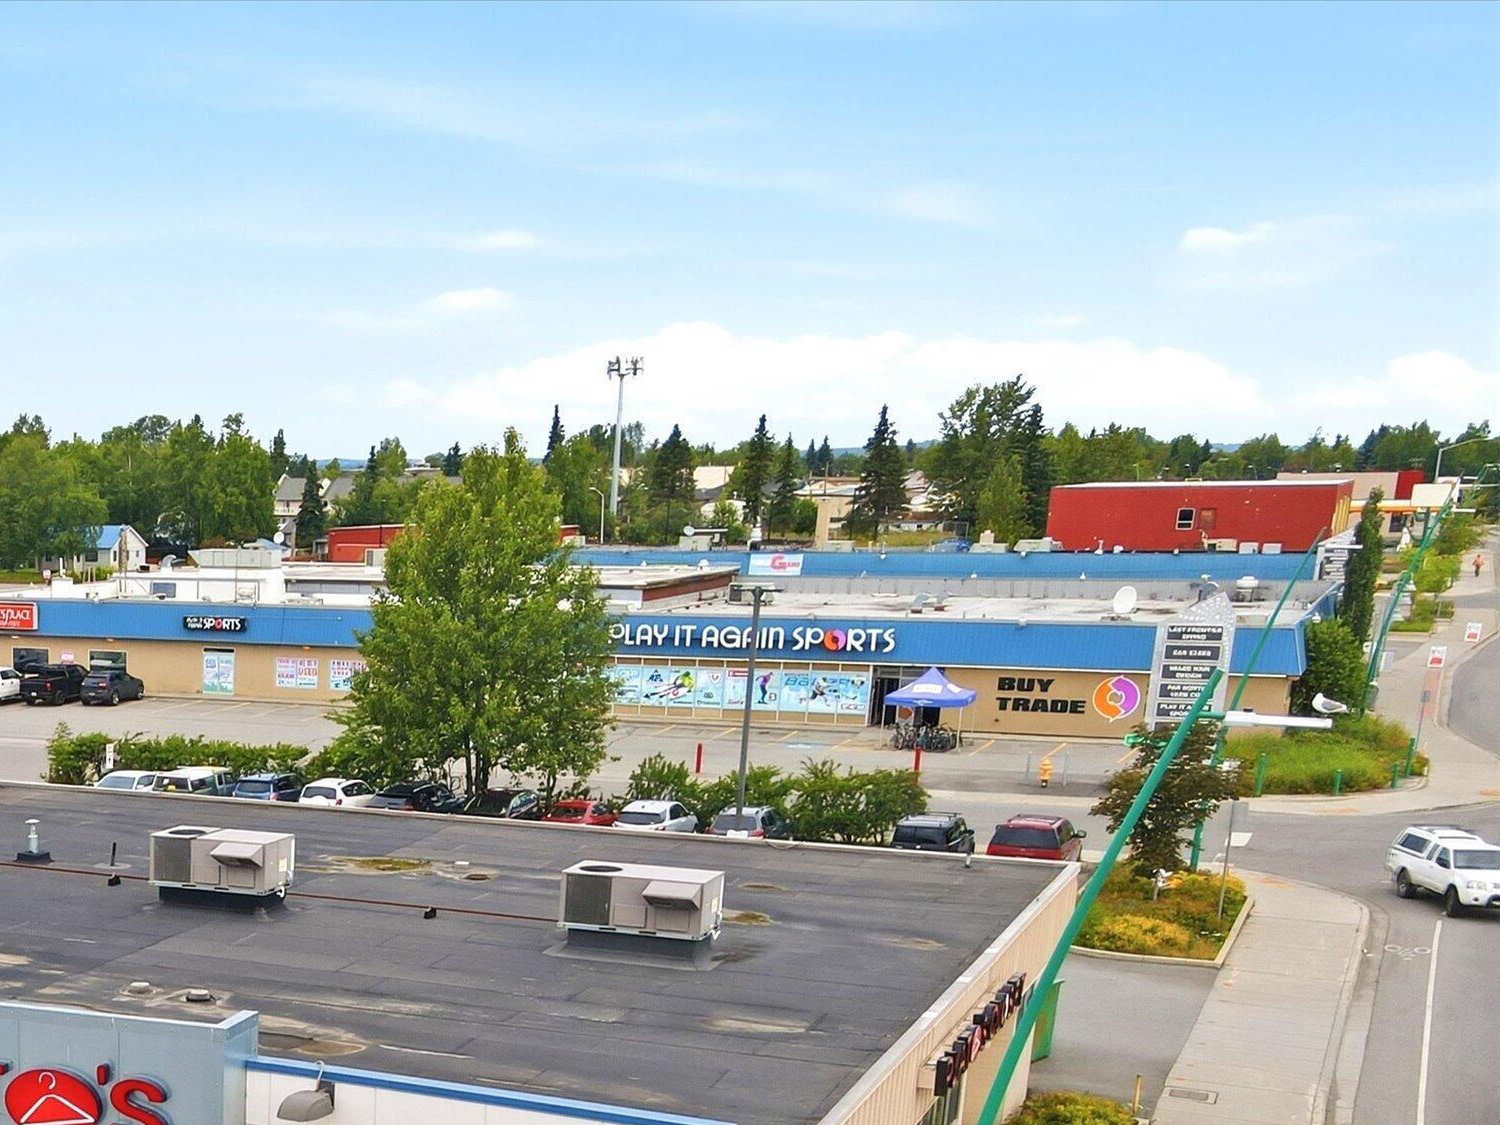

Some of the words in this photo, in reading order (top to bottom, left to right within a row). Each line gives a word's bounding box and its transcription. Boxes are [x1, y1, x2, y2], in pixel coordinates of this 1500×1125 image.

[203, 618, 242, 631] SPORTS
[608, 622, 669, 647] PLAY
[673, 624, 697, 648] IT
[701, 625, 785, 650] AGAIN
[791, 626, 896, 653] SPORTS
[997, 677, 1054, 692] BUY
[996, 697, 1087, 714] TRADE
